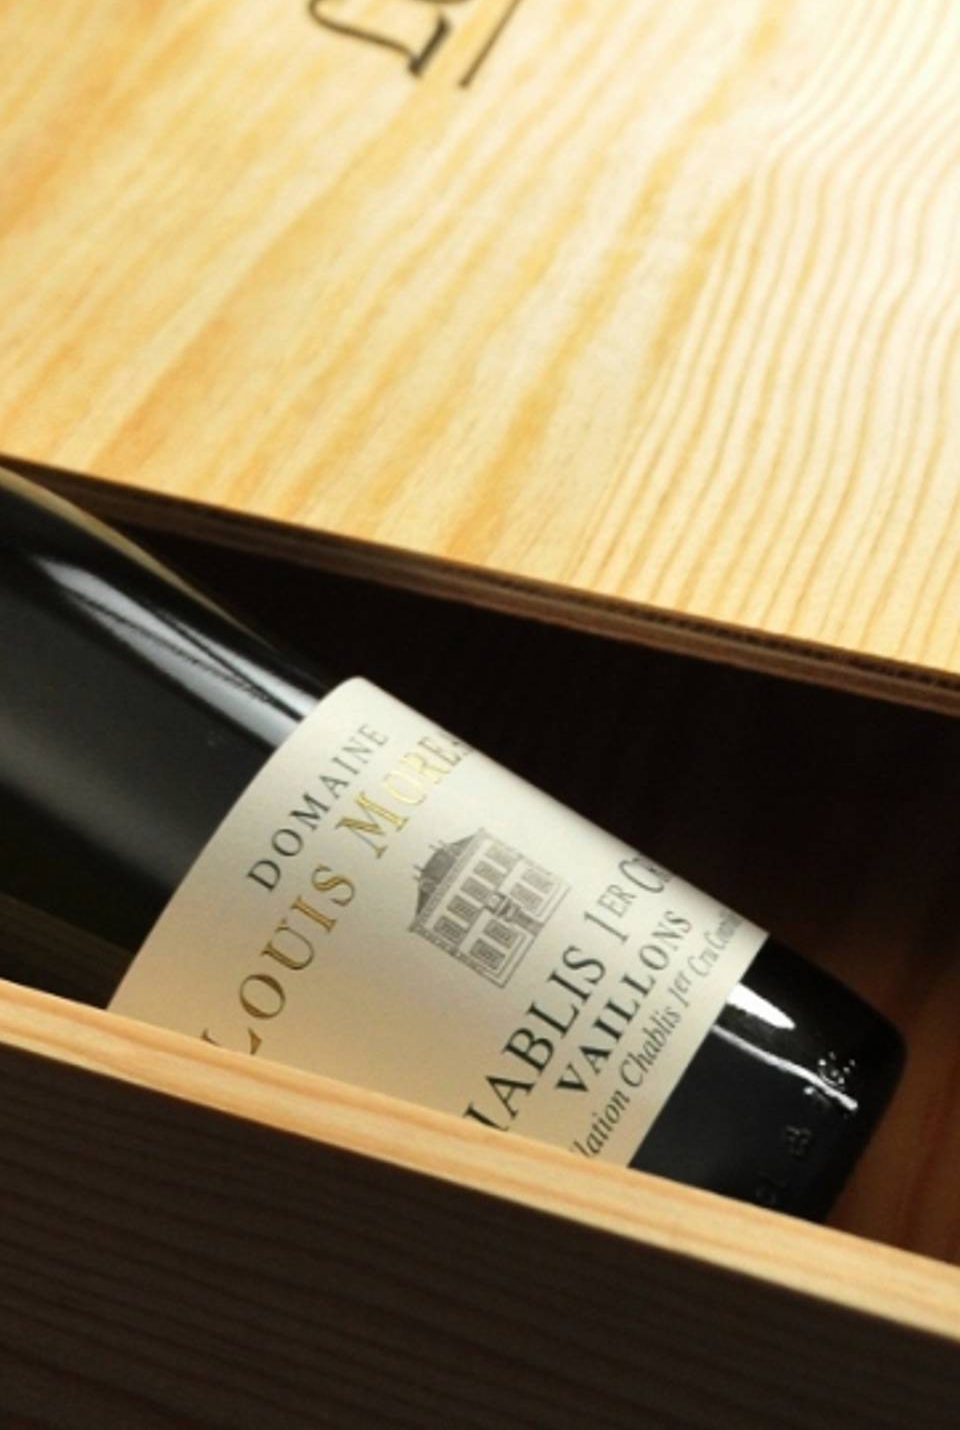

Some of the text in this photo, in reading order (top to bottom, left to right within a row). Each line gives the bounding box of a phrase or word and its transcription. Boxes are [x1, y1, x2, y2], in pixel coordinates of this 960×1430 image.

[246, 723, 389, 892] DOMAINE
[554, 910, 692, 1097] VAILLONS
[569, 1090, 630, 1158] lation
[619, 1006, 681, 1088] Chablis
